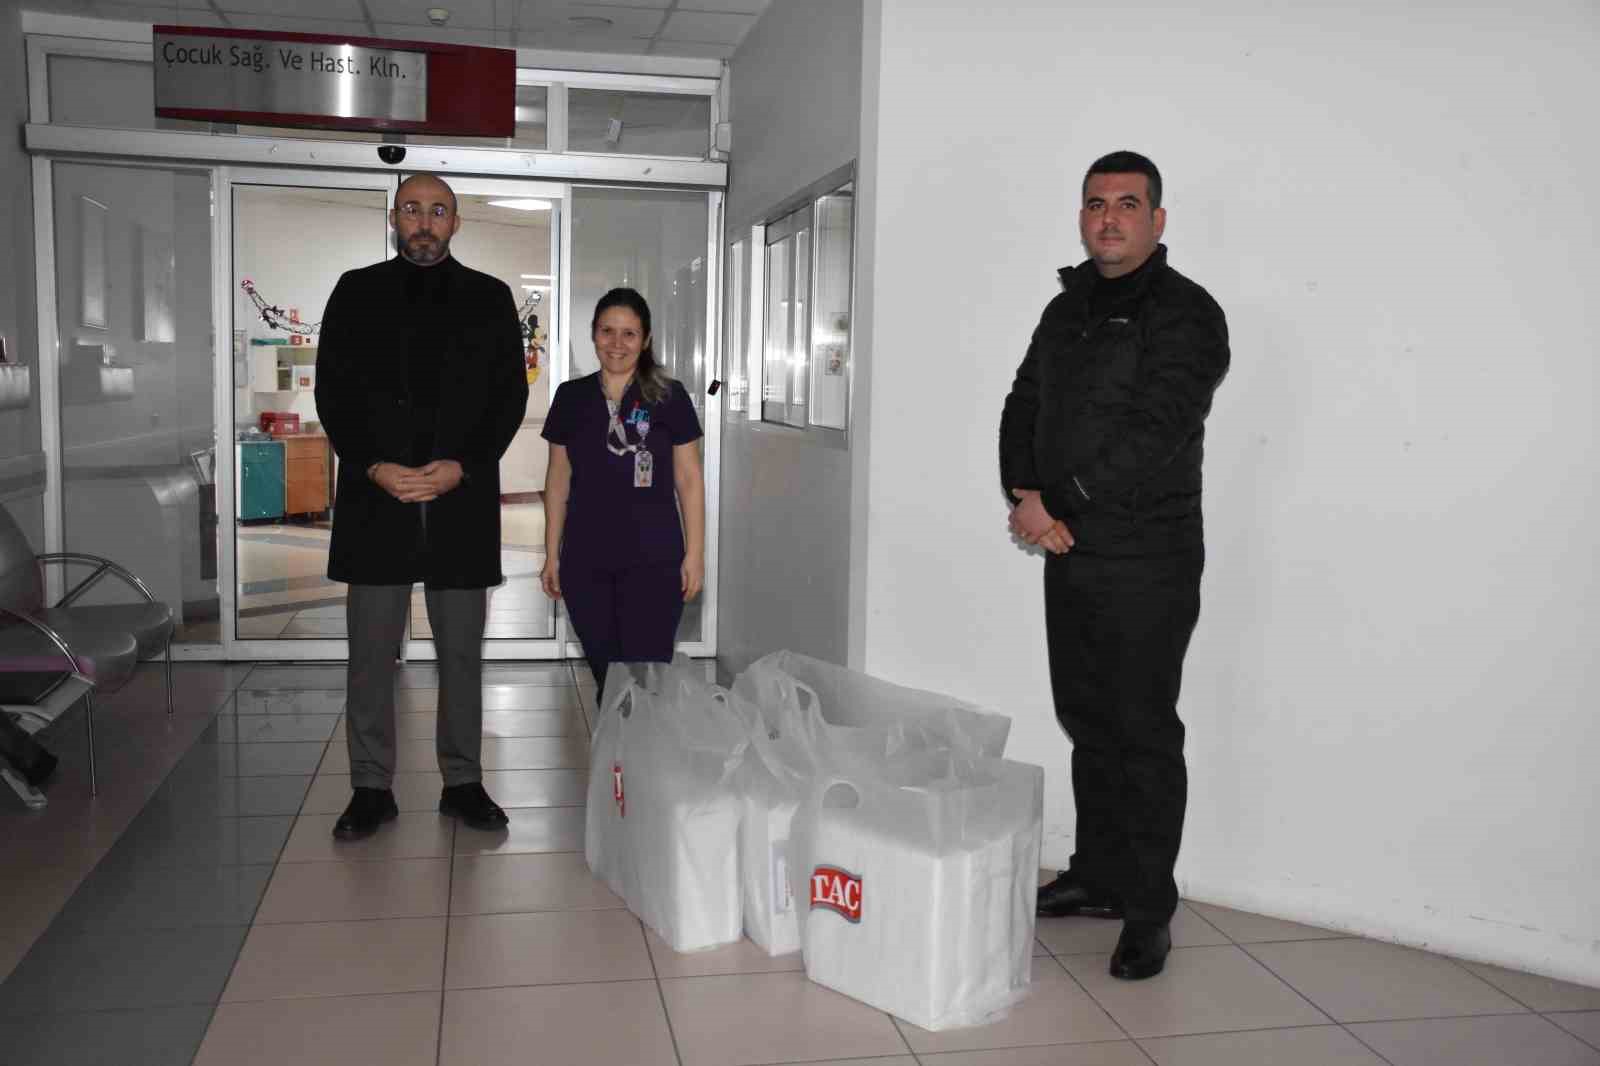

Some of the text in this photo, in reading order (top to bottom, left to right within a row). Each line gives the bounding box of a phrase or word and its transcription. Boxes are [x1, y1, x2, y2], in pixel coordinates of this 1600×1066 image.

[163, 41, 406, 79] Çocuk Sağ. Ve Hast. Kln.
